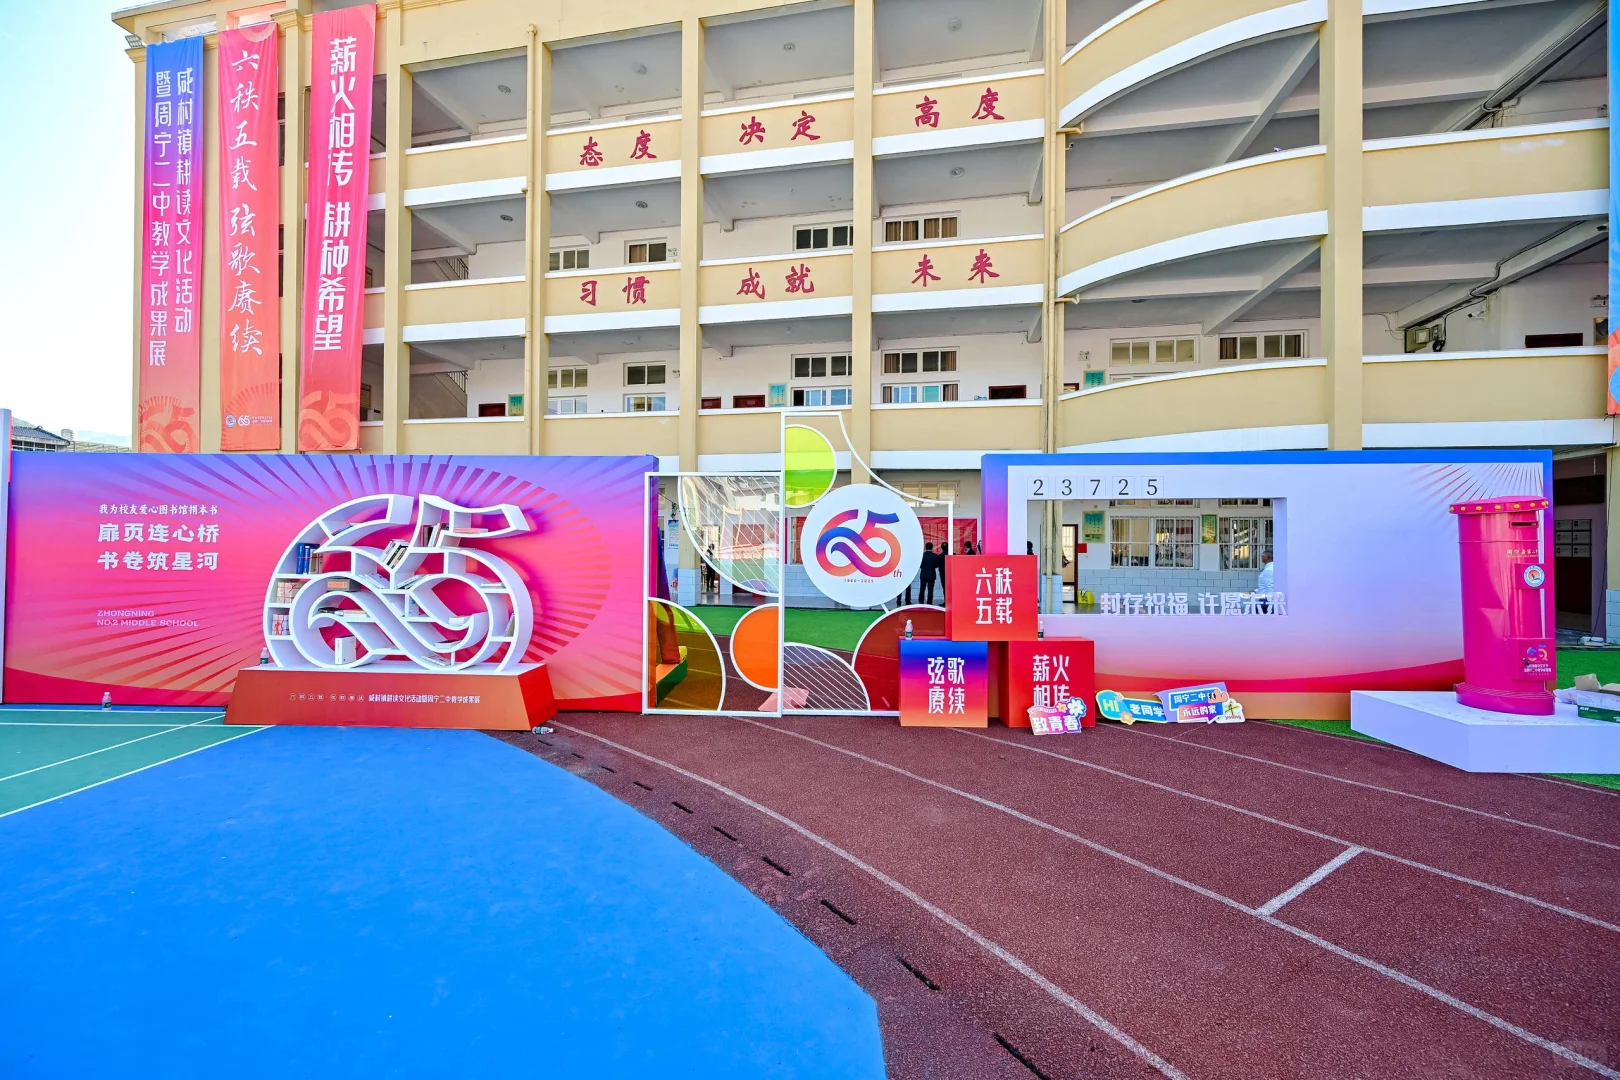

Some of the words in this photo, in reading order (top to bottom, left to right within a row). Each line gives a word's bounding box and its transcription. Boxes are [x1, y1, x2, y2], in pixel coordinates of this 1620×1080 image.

[327, 36, 358, 188] 薪火相传
[174, 67, 194, 334] 咸村镇耕读文化活动
[149, 71, 172, 367] 暨周宁二中教学成果展
[313, 201, 351, 351] 耕种希望
[99, 503, 218, 516] 我为校友爱心图书馆捐本书
[97, 522, 220, 544] 扉页连心桥
[97, 550, 220, 571] 书卷筑星河
[975, 567, 1012, 595] 六秩
[975, 597, 1012, 624] 五载
[1100, 592, 1188, 616] 封存祝福
[1197, 591, 1287, 616] 许愿未来
[927, 657, 965, 685] 弦歌
[1032, 654, 1070, 682] 薪火
[1129, 703, 1165, 717] 老同学
[1182, 704, 1217, 717] 永远的家
[1031, 716, 1079, 732] 致青春
